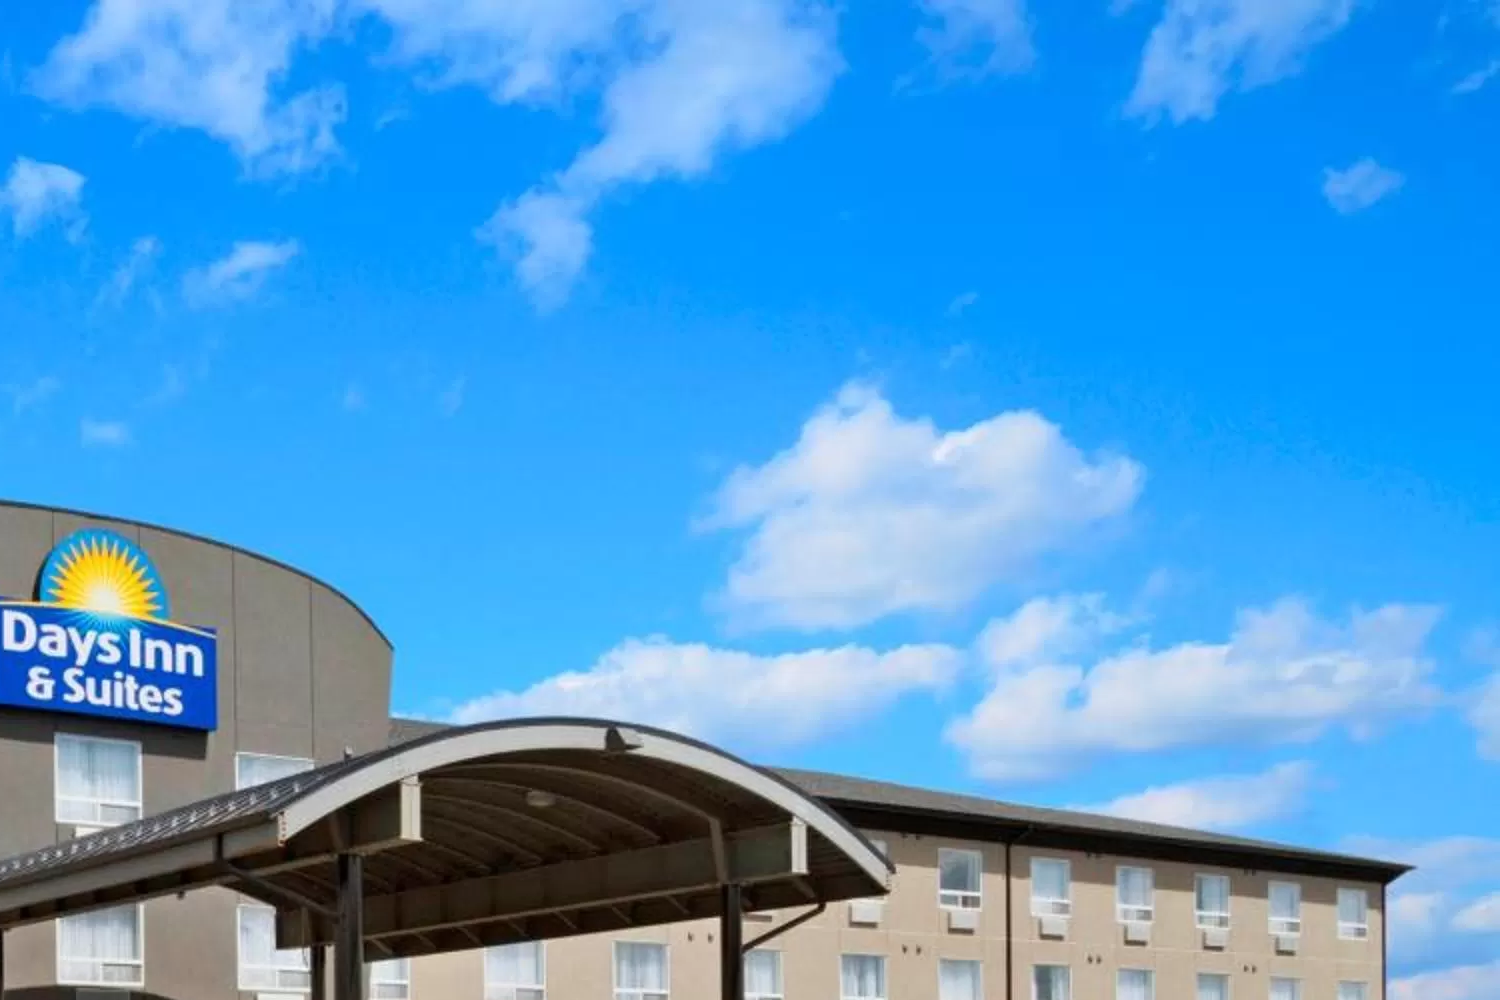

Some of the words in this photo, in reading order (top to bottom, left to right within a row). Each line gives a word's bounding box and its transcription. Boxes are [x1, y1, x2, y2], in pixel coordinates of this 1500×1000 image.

[2, 609, 122, 667] Days
[129, 628, 204, 677] Inn
[26, 665, 55, 700] &
[62, 667, 184, 716] Suites
